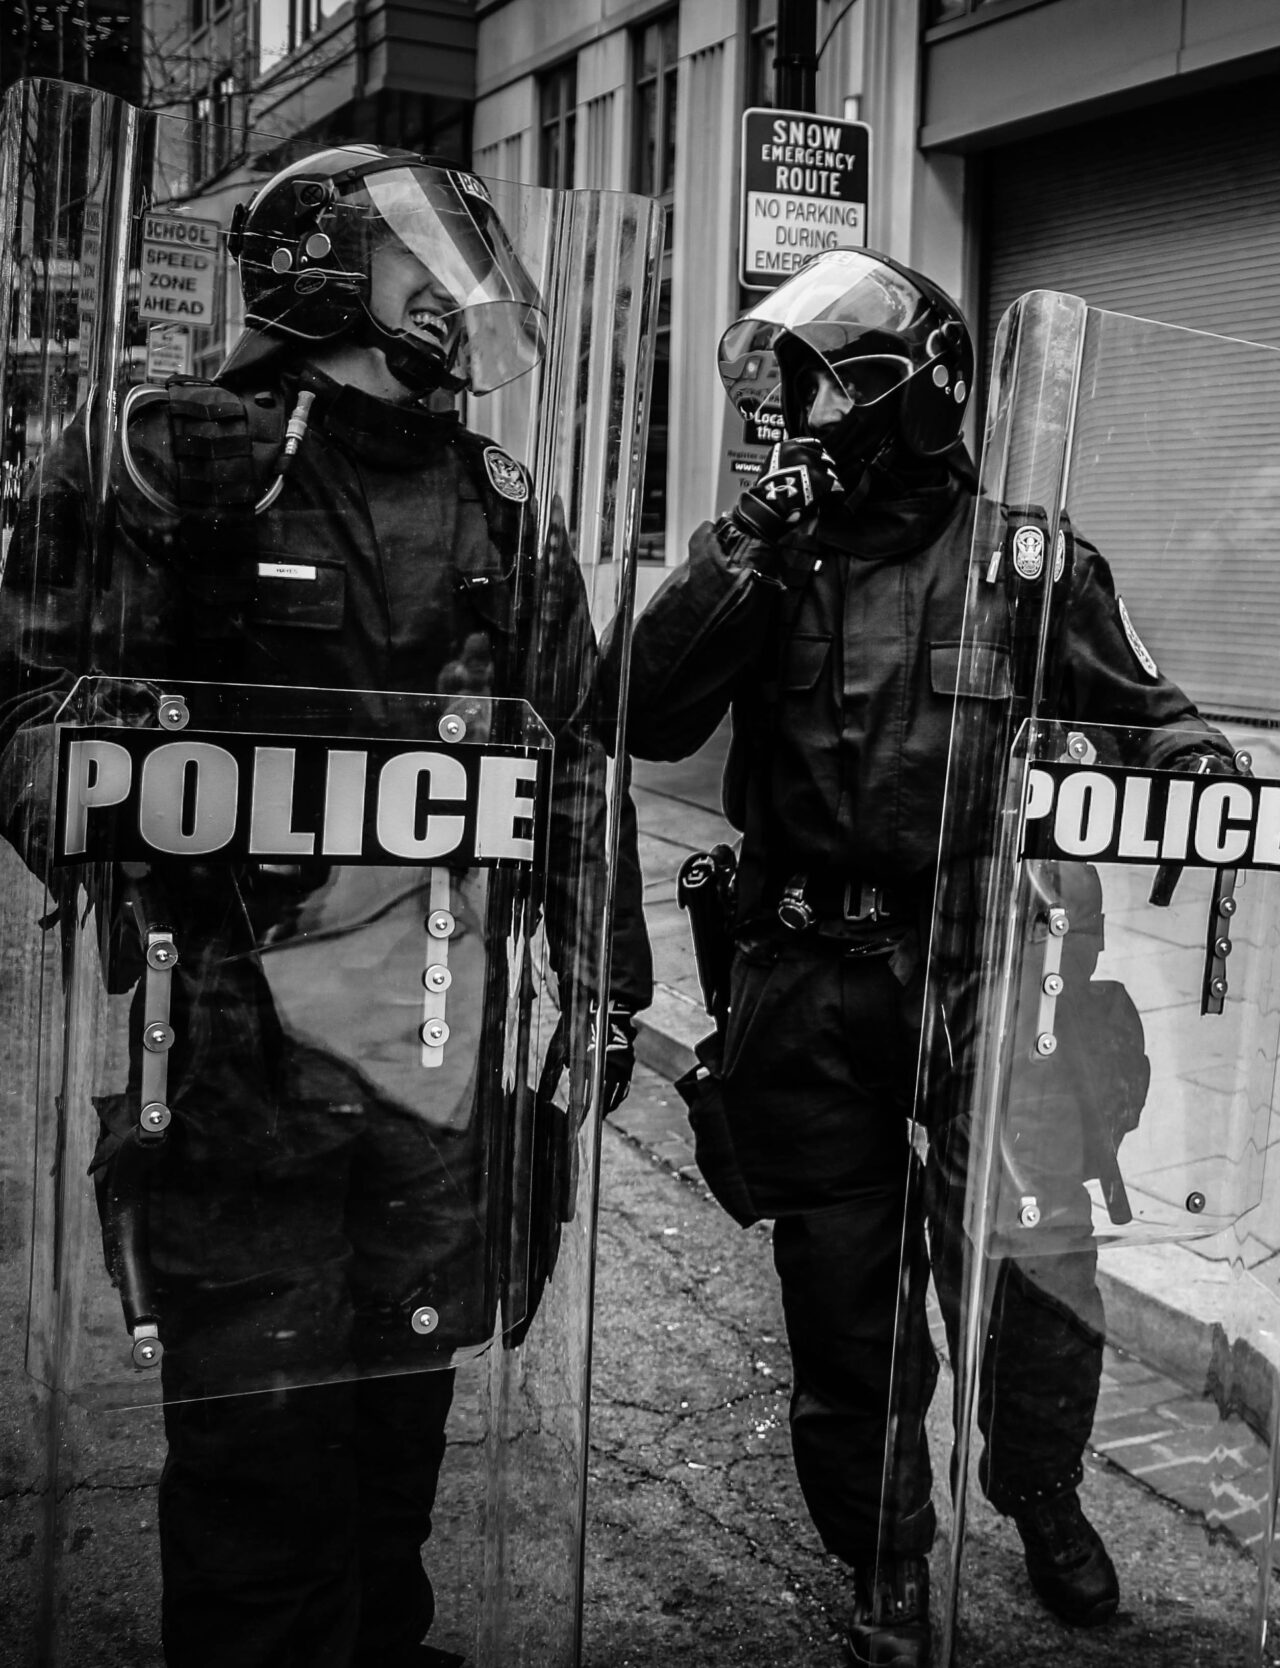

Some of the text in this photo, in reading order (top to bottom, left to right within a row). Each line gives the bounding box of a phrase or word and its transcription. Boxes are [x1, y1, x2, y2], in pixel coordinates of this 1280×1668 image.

[772, 119, 842, 150] SNOW
[761, 144, 856, 171] EMERGENCY
[775, 165, 842, 196] ROUTE
[754, 198, 858, 227] NO PARKING
[147, 222, 210, 243] SCHOOL
[775, 226, 838, 249] DURING
[146, 249, 208, 270] SPEED
[149, 273, 197, 292] ZONE
[143, 296, 205, 315] AHEAD
[757, 425, 781, 441] the
[64, 740, 539, 862] POLICE
